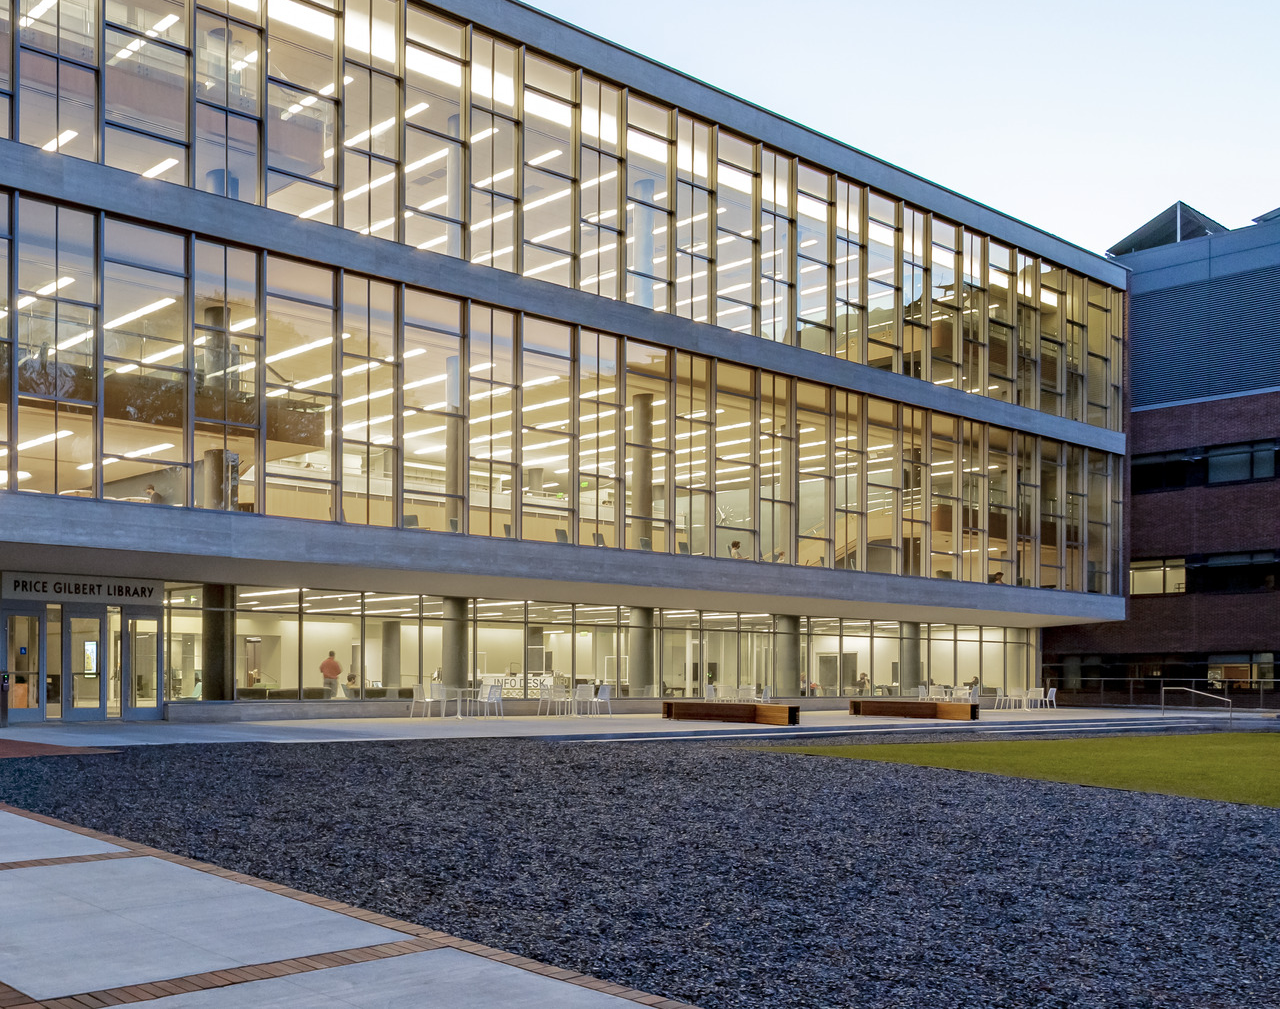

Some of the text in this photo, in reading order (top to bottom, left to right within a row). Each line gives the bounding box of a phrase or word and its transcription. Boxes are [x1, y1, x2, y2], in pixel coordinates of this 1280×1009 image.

[13, 579, 154, 598] PRICE GILBERT LIBRARY
[493, 678, 517, 688] INFO
